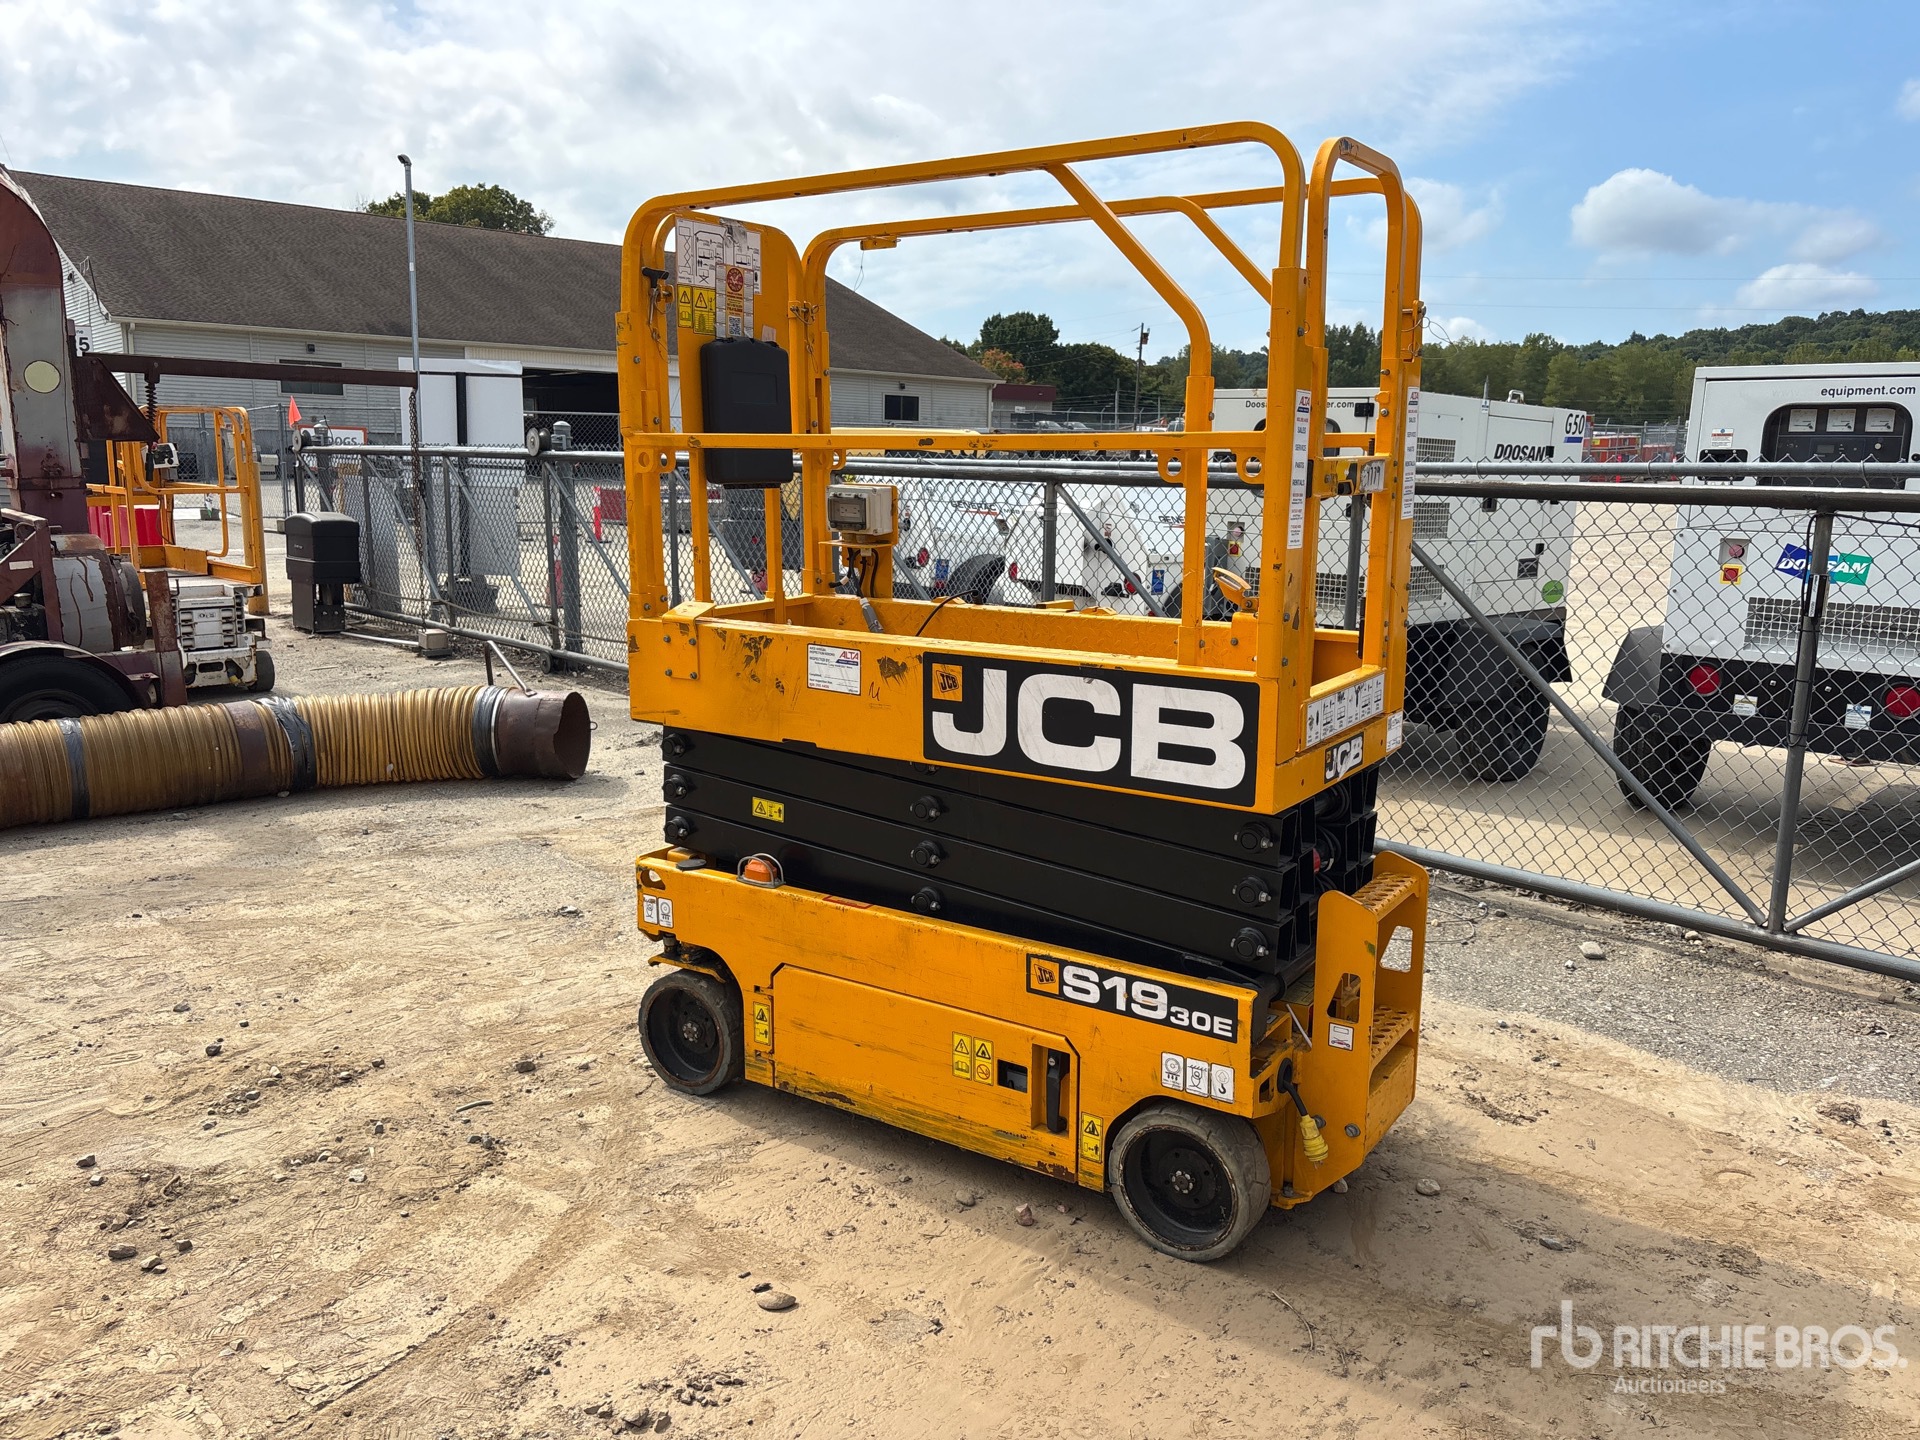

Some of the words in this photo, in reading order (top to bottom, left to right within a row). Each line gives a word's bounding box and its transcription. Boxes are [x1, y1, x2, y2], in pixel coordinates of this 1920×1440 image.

[1820, 385, 1916, 398] equipment.com
[1245, 400, 1267, 408] Doos
[1565, 413, 1585, 435] G50
[1494, 443, 1546, 461] DOOSAN
[1158, 515, 1185, 524] GENE
[1777, 557, 1869, 574] DOSAN
[839, 651, 859, 660] ALTA
[940, 672, 958, 690] JCB
[932, 668, 1246, 790] JCB
[1325, 736, 1363, 780] JCB
[1037, 967, 1055, 984] JCB
[1062, 965, 1168, 1020] S19
[1169, 1005, 1233, 1037] 30E
